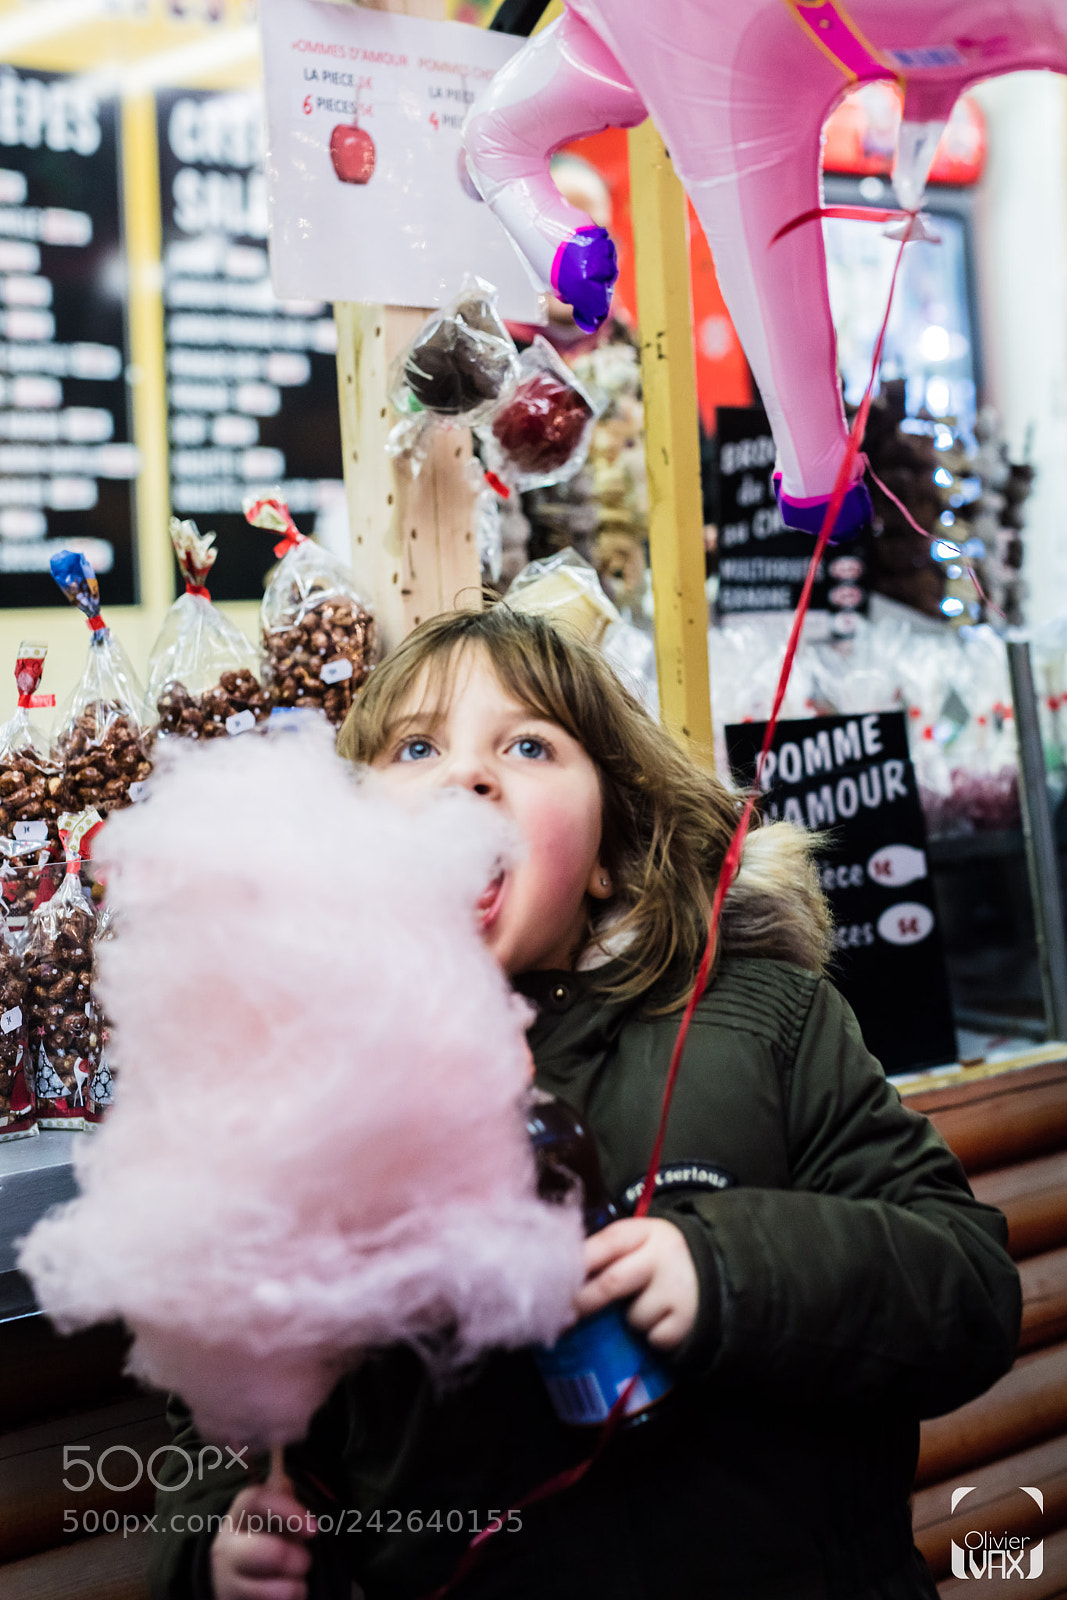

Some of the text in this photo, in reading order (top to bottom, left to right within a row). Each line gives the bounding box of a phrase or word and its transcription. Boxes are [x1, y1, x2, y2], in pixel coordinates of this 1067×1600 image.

[303, 68, 318, 81] LA
[322, 70, 354, 87] PIECE
[428, 87, 441, 98] LA
[303, 94, 313, 115] 6
[317, 97, 358, 114] PIECES
[429, 111, 439, 132] 4
[757, 713, 884, 791] POMME
[763, 759, 909, 829] 'AMOUR
[664, 1166, 728, 1189] serious
